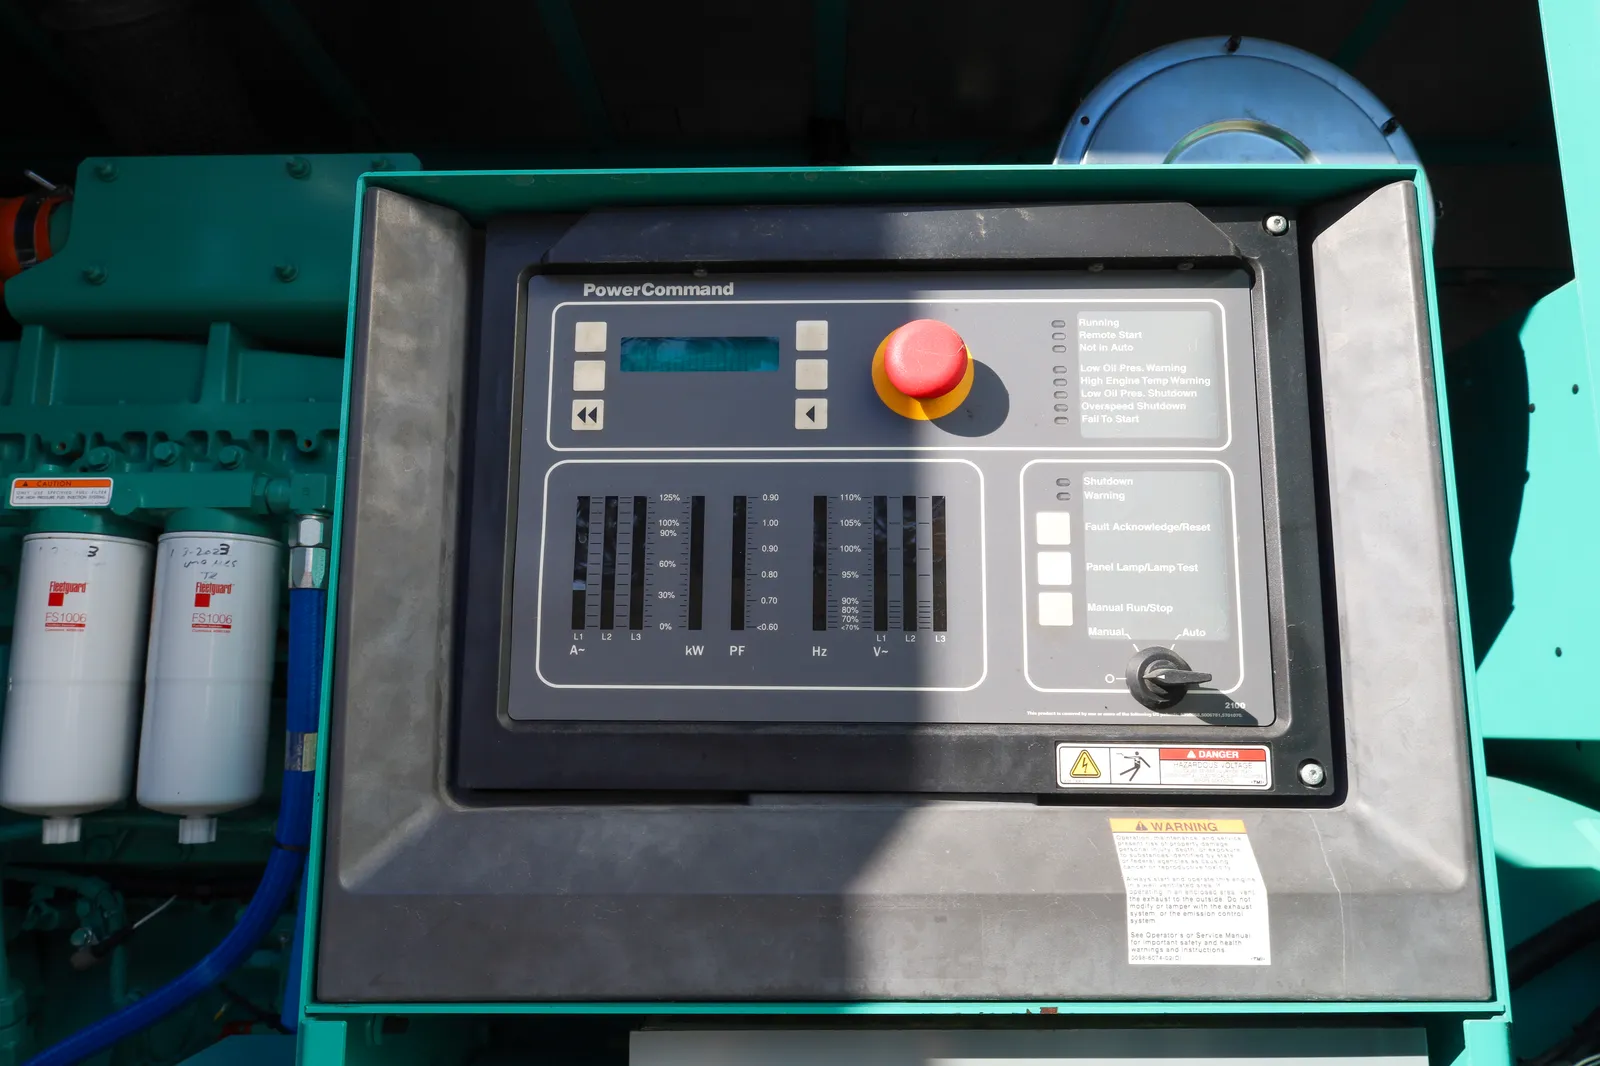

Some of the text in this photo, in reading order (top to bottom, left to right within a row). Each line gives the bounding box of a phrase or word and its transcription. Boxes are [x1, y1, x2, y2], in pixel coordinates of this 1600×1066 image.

[584, 282, 734, 297] PowerCommand
[1079, 319, 1120, 328] Running
[1079, 331, 1142, 340] Remote Start
[1111, 344, 1134, 352] Auto
[1080, 364, 1187, 374] Low Oil Pres. Warning
[1080, 376, 1210, 387] High Engine Temp Warning
[1081, 389, 1197, 398] Low Oil Pres. Shutdown
[1082, 402, 1186, 412] Overspeed Shutdown
[1082, 415, 1140, 423] Fail To Start
[1084, 477, 1133, 486] Shutdown
[1084, 491, 1125, 501] Warning
[659, 519, 680, 527] 100%
[763, 519, 779, 527] 1.00
[840, 519, 862, 527] 105%
[1085, 522, 1211, 533] Fault Acknowledge/Reset
[840, 545, 862, 553] 100%
[659, 560, 676, 568] 60%
[1086, 563, 1199, 573] Panel Lamp/Lamp Test
[842, 571, 859, 579] 95%
[49, 581, 87, 595] Fleetguard
[196, 582, 233, 595] Fleetguard
[842, 597, 859, 605] 90%
[842, 606, 859, 614] 80%
[1088, 603, 1173, 615] Manual Run/Stop
[45, 612, 87, 622] FS1006
[192, 613, 233, 624] FS1006
[842, 615, 859, 623] 70%
[757, 623, 778, 631] <0.60
[1088, 627, 1125, 637] Manual
[1183, 628, 1206, 637] Auto
[602, 633, 612, 641] L2
[631, 633, 641, 641] L3
[936, 635, 946, 643] L3
[686, 646, 704, 656] kW
[730, 646, 745, 656] PF
[813, 646, 827, 657] Hz
[1226, 700, 1250, 711] 2100
[1198, 750, 1239, 759] DANGER
[1151, 823, 1218, 832] WARNING
[1131, 932, 1143, 940] See
[1186, 932, 1194, 940] or
[1196, 932, 1223, 940] Service
[1225, 932, 1250, 940] Manual
